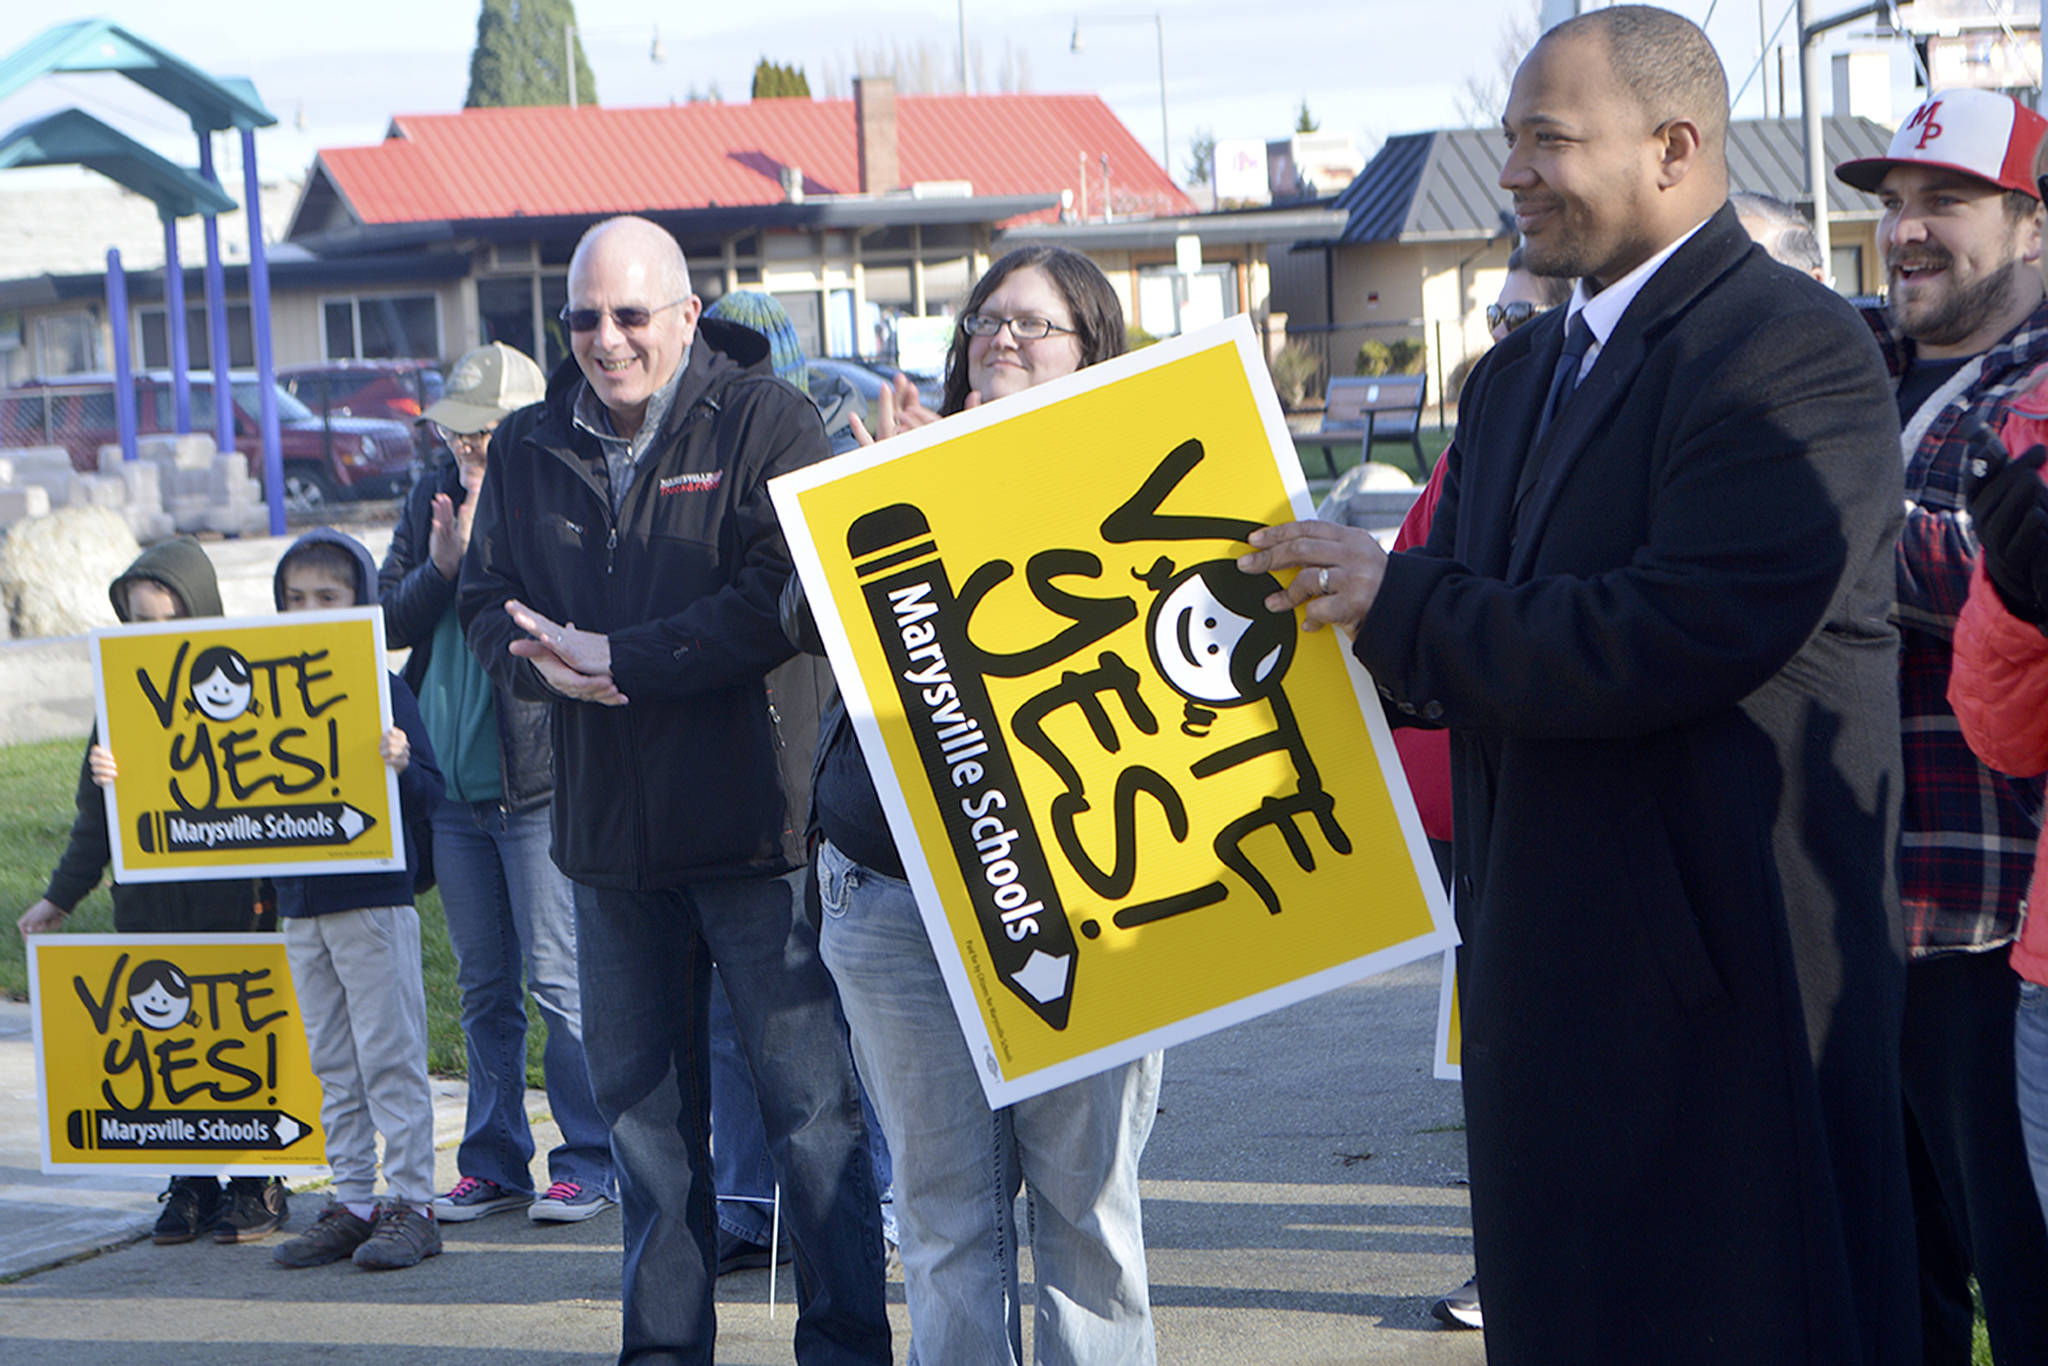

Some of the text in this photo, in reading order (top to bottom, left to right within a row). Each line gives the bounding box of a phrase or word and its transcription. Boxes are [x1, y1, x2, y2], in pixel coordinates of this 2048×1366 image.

[169, 718, 340, 811] YES!
[888, 582, 1045, 941] Marysville Schools
[954, 548, 1231, 941] YES!
[170, 811, 335, 847] Marysville Schools
[101, 1029, 277, 1112] YES!
[102, 1118, 270, 1146] Marysville Schools
